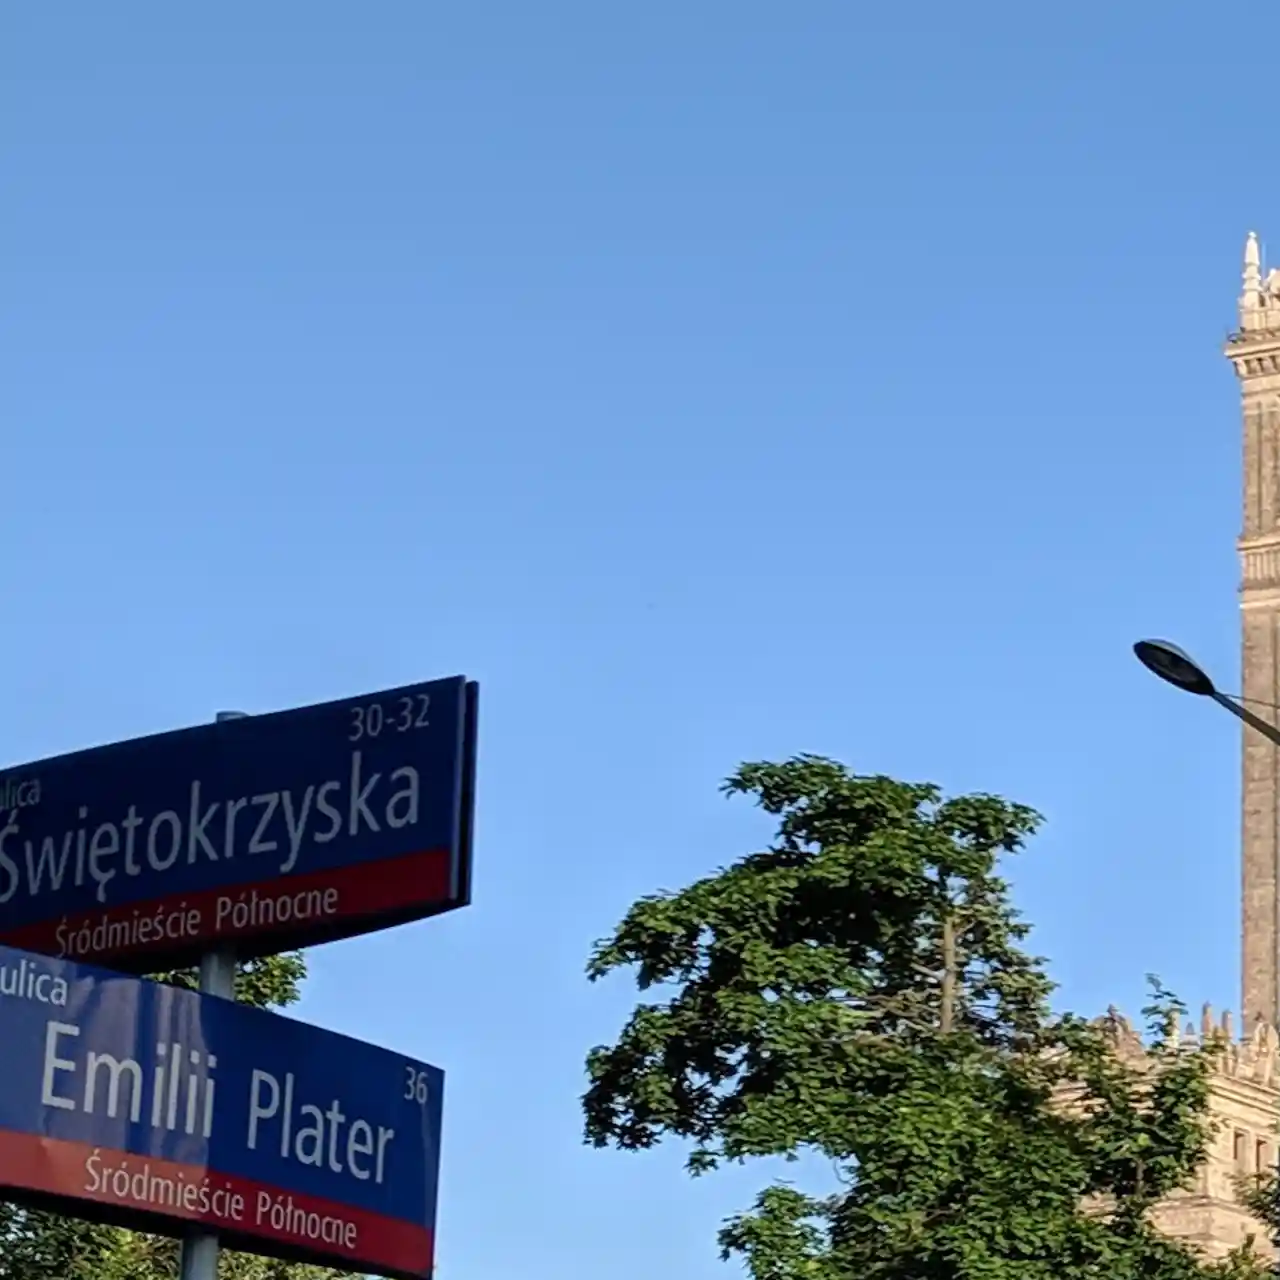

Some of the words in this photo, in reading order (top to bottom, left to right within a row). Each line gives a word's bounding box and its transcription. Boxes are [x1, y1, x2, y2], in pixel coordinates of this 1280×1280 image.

[348, 693, 431, 742] 30-32
[0, 750, 421, 903] Świętokrzyska
[55, 906, 201, 958] Śródmieście
[215, 887, 339, 932] Północne
[0, 958, 68, 1007] ulica
[41, 1020, 217, 1139] Emilii
[247, 1067, 396, 1185] Plater
[403, 1065, 430, 1105] 36
[84, 1148, 245, 1221] Śródmieście
[255, 1190, 358, 1250] Północne
